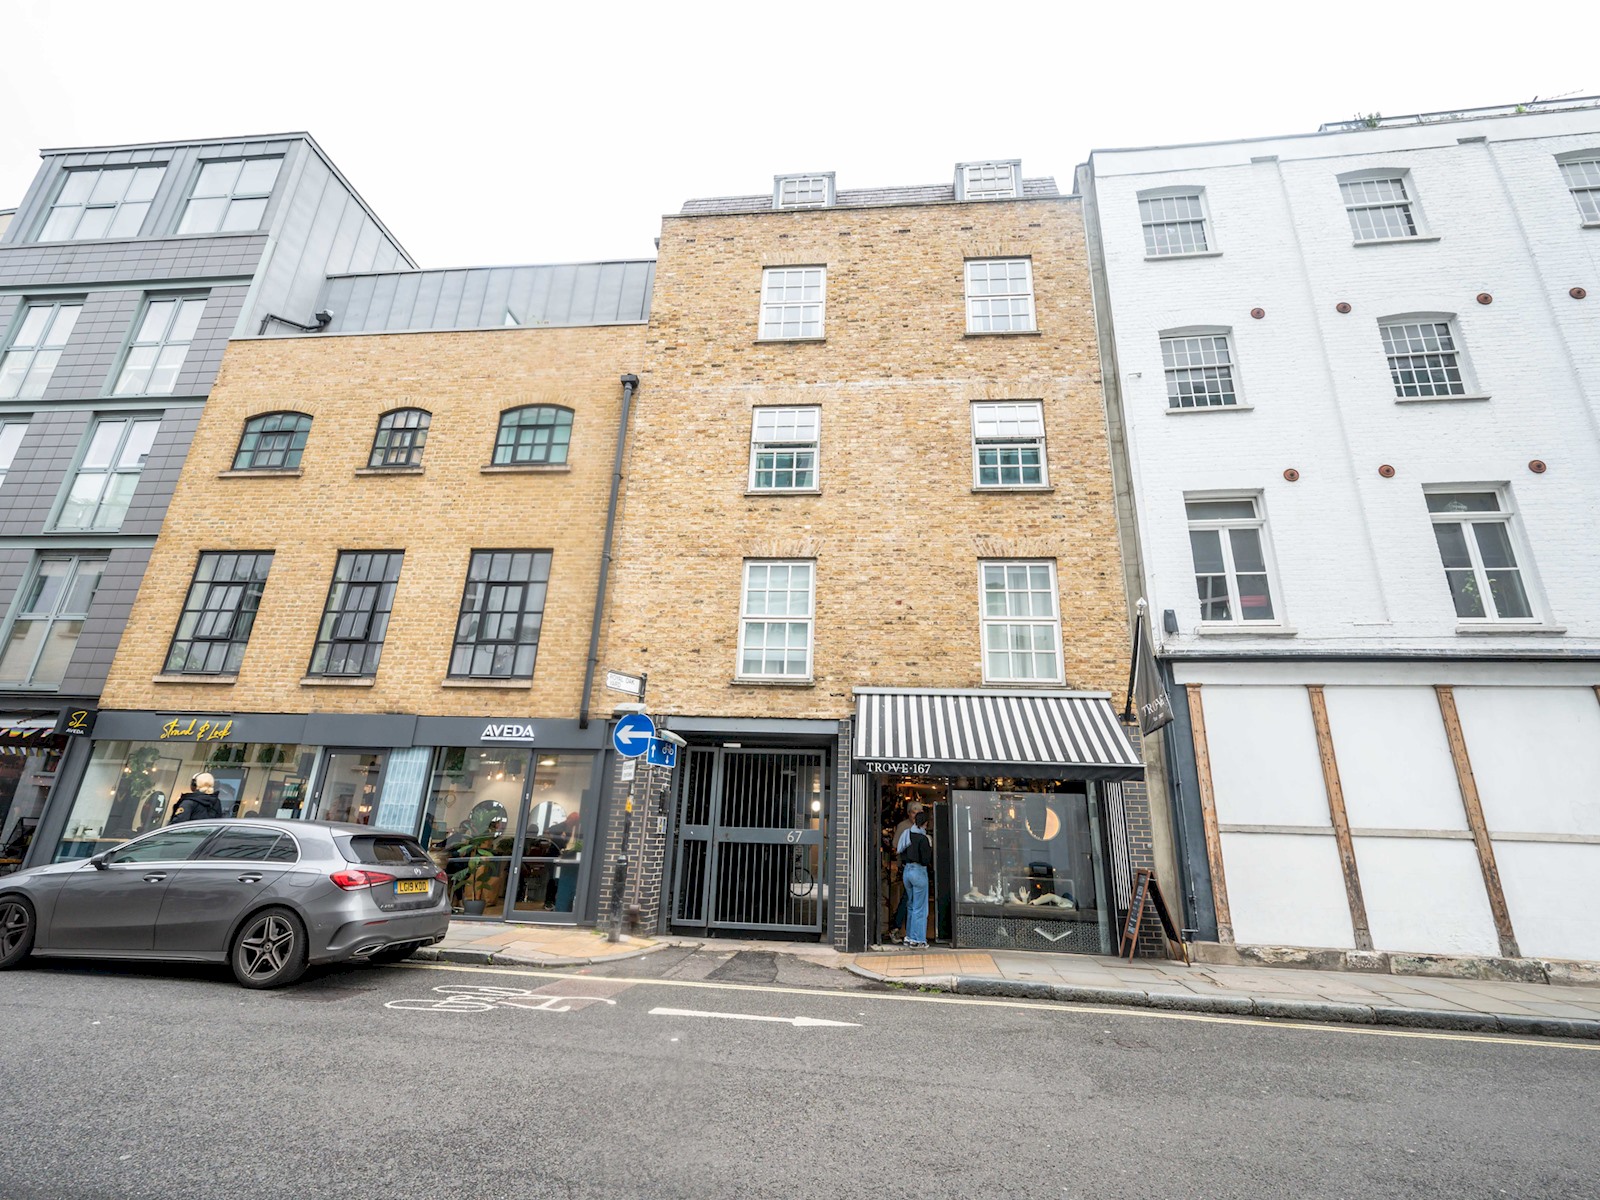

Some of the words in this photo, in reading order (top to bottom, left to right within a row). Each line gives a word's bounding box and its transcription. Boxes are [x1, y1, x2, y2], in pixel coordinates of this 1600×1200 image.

[160, 718, 194, 739] Strand
[196, 720, 210, 741] &
[206, 720, 233, 741] Lock
[481, 724, 535, 738] AVEDA
[787, 830, 803, 843] 67
